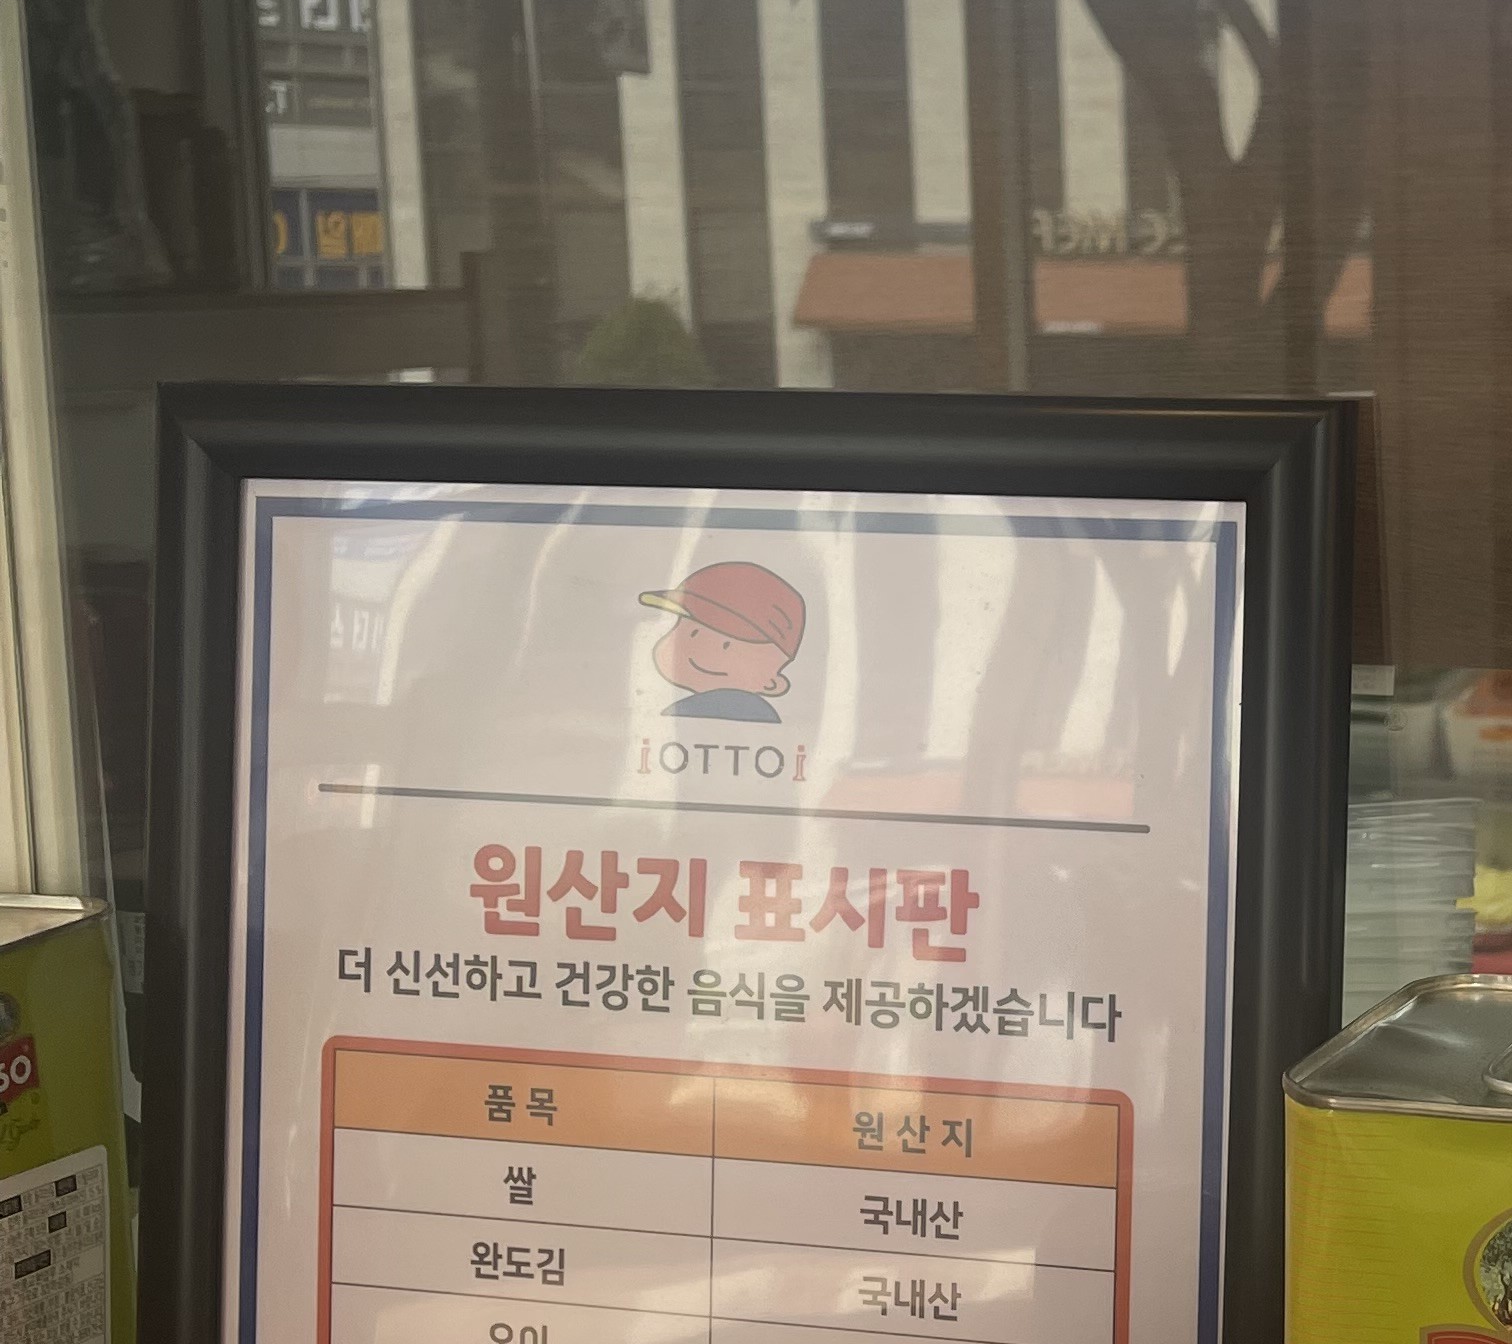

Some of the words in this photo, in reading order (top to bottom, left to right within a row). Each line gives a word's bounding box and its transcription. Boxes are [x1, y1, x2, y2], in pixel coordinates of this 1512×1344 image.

[470, 843, 706, 941] 원산지
[734, 860, 981, 963] 표시판
[337, 949, 374, 995] 더
[387, 949, 543, 1004] 신선하고
[555, 961, 675, 1013] 건강한
[687, 971, 811, 1025] 음식을
[823, 981, 1122, 1042] 제공하겠습니다
[503, 1166, 537, 1207] 쌀
[859, 1194, 964, 1241] 국내산
[470, 1242, 567, 1287] 완도김
[858, 1276, 962, 1323] 국내산
